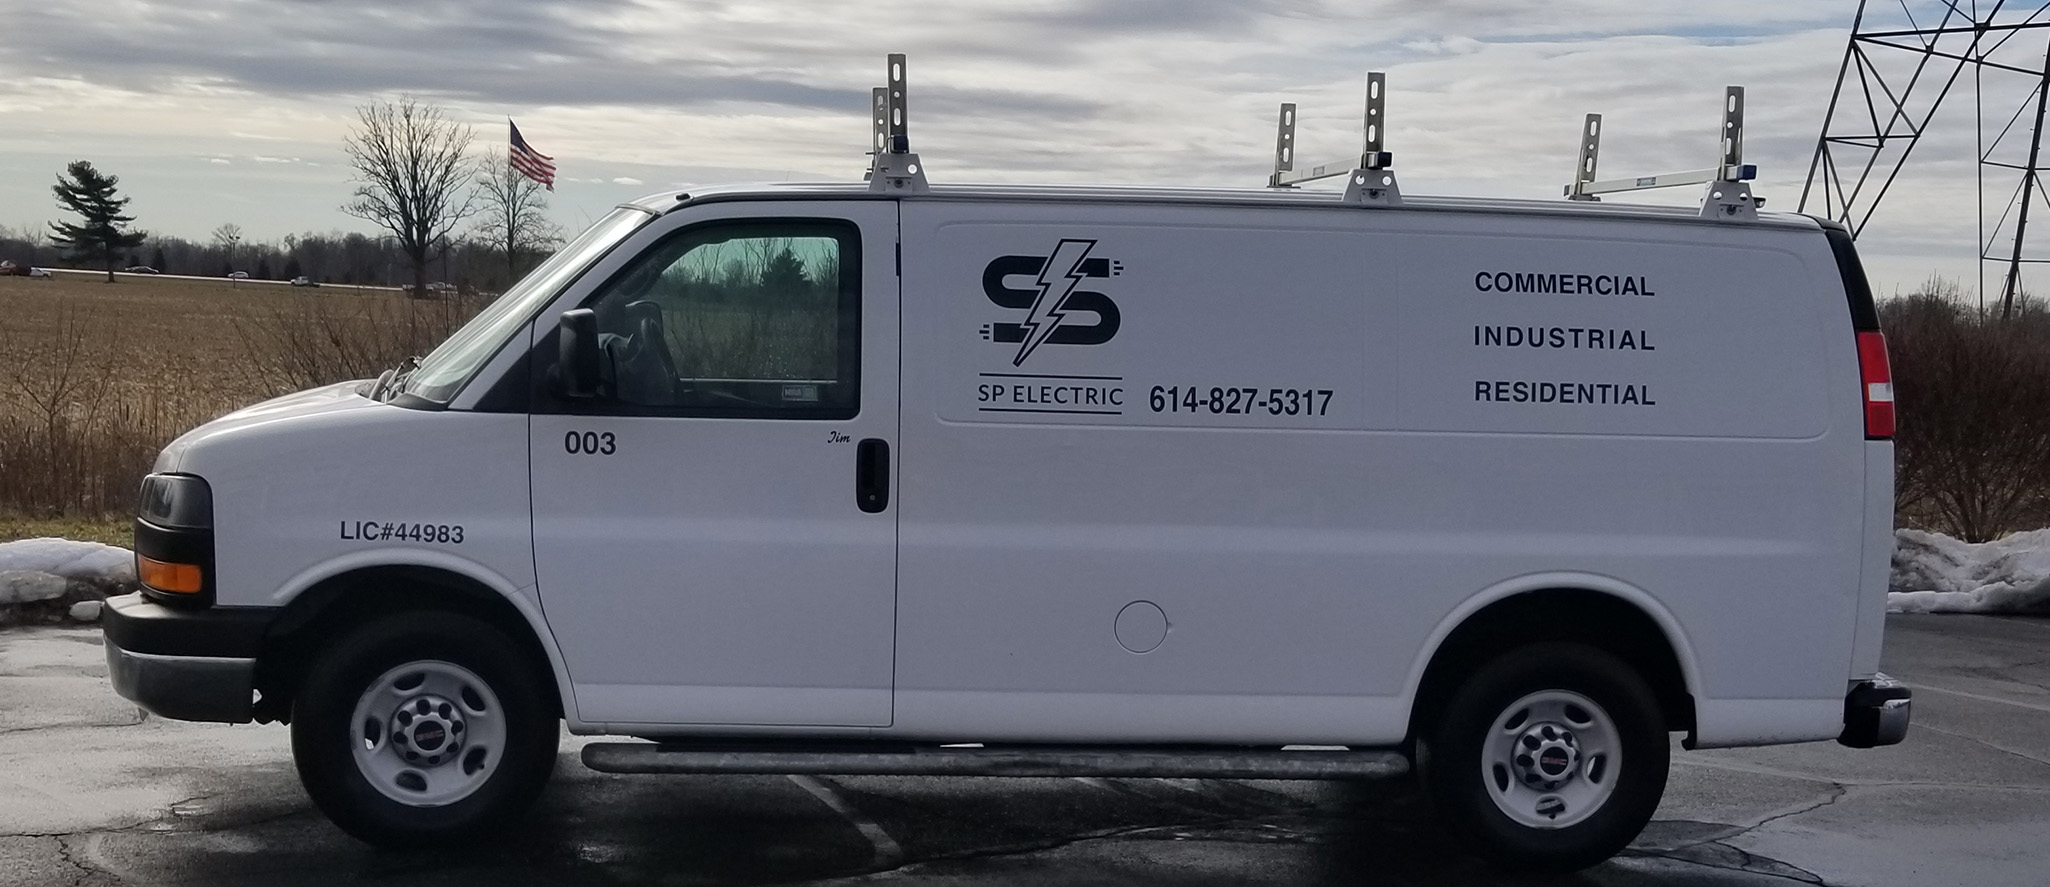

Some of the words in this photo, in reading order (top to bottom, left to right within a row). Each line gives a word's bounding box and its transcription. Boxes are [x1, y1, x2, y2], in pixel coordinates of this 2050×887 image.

[1475, 271, 1655, 297] COMMERCIAL
[1474, 325, 1656, 351] INDUSTRIAL
[978, 384, 1005, 402] SP
[1012, 385, 1124, 405] ELECTRIC
[1149, 385, 1334, 416] 614-827-5317
[1474, 380, 1656, 406] RESIDENTIAL
[564, 430, 616, 456] 003
[827, 430, 851, 444] Jim
[340, 520, 464, 544] LIC#44983
